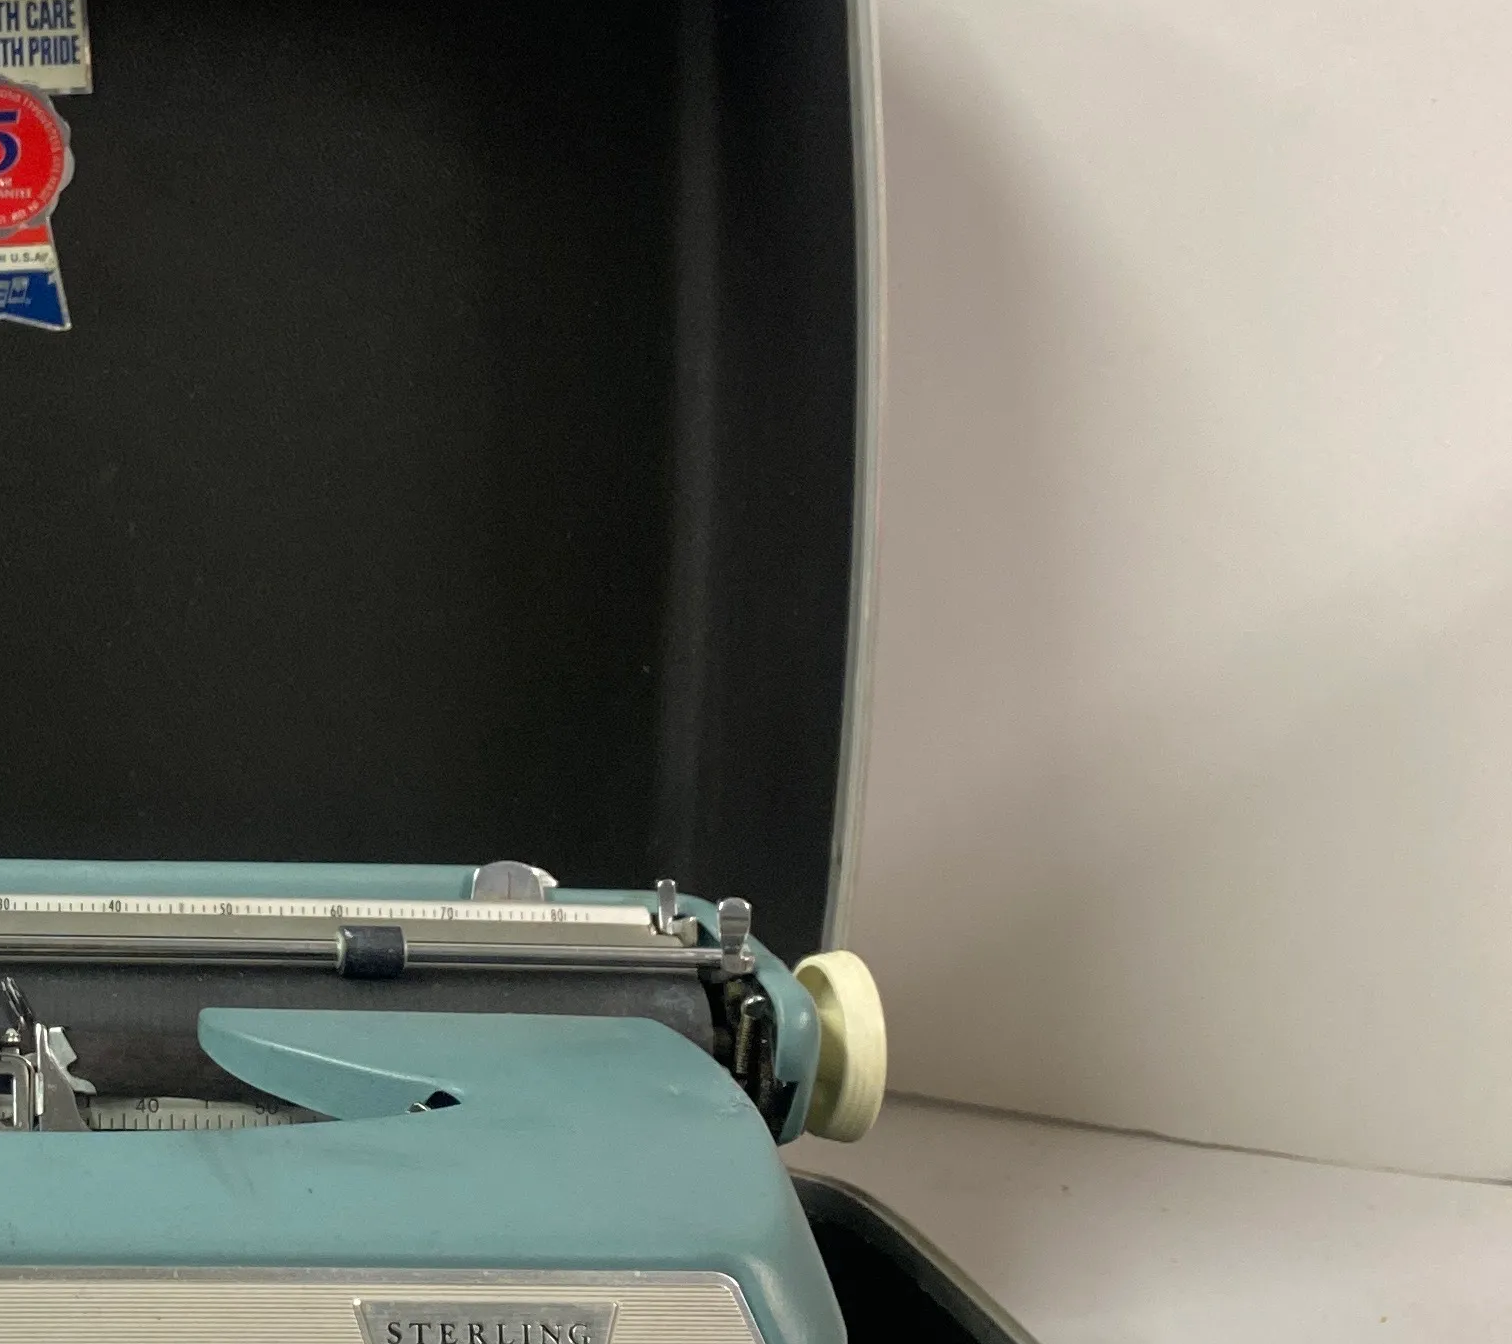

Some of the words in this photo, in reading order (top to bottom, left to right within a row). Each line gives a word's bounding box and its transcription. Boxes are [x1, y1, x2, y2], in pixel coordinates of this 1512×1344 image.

[28, 35, 81, 67] PRIDE
[108, 899, 122, 913] 40
[219, 902, 233, 916] 50
[330, 905, 343, 918] 60
[440, 906, 454, 920] 70
[550, 909, 563, 922] 80
[136, 1098, 159, 1113] 40
